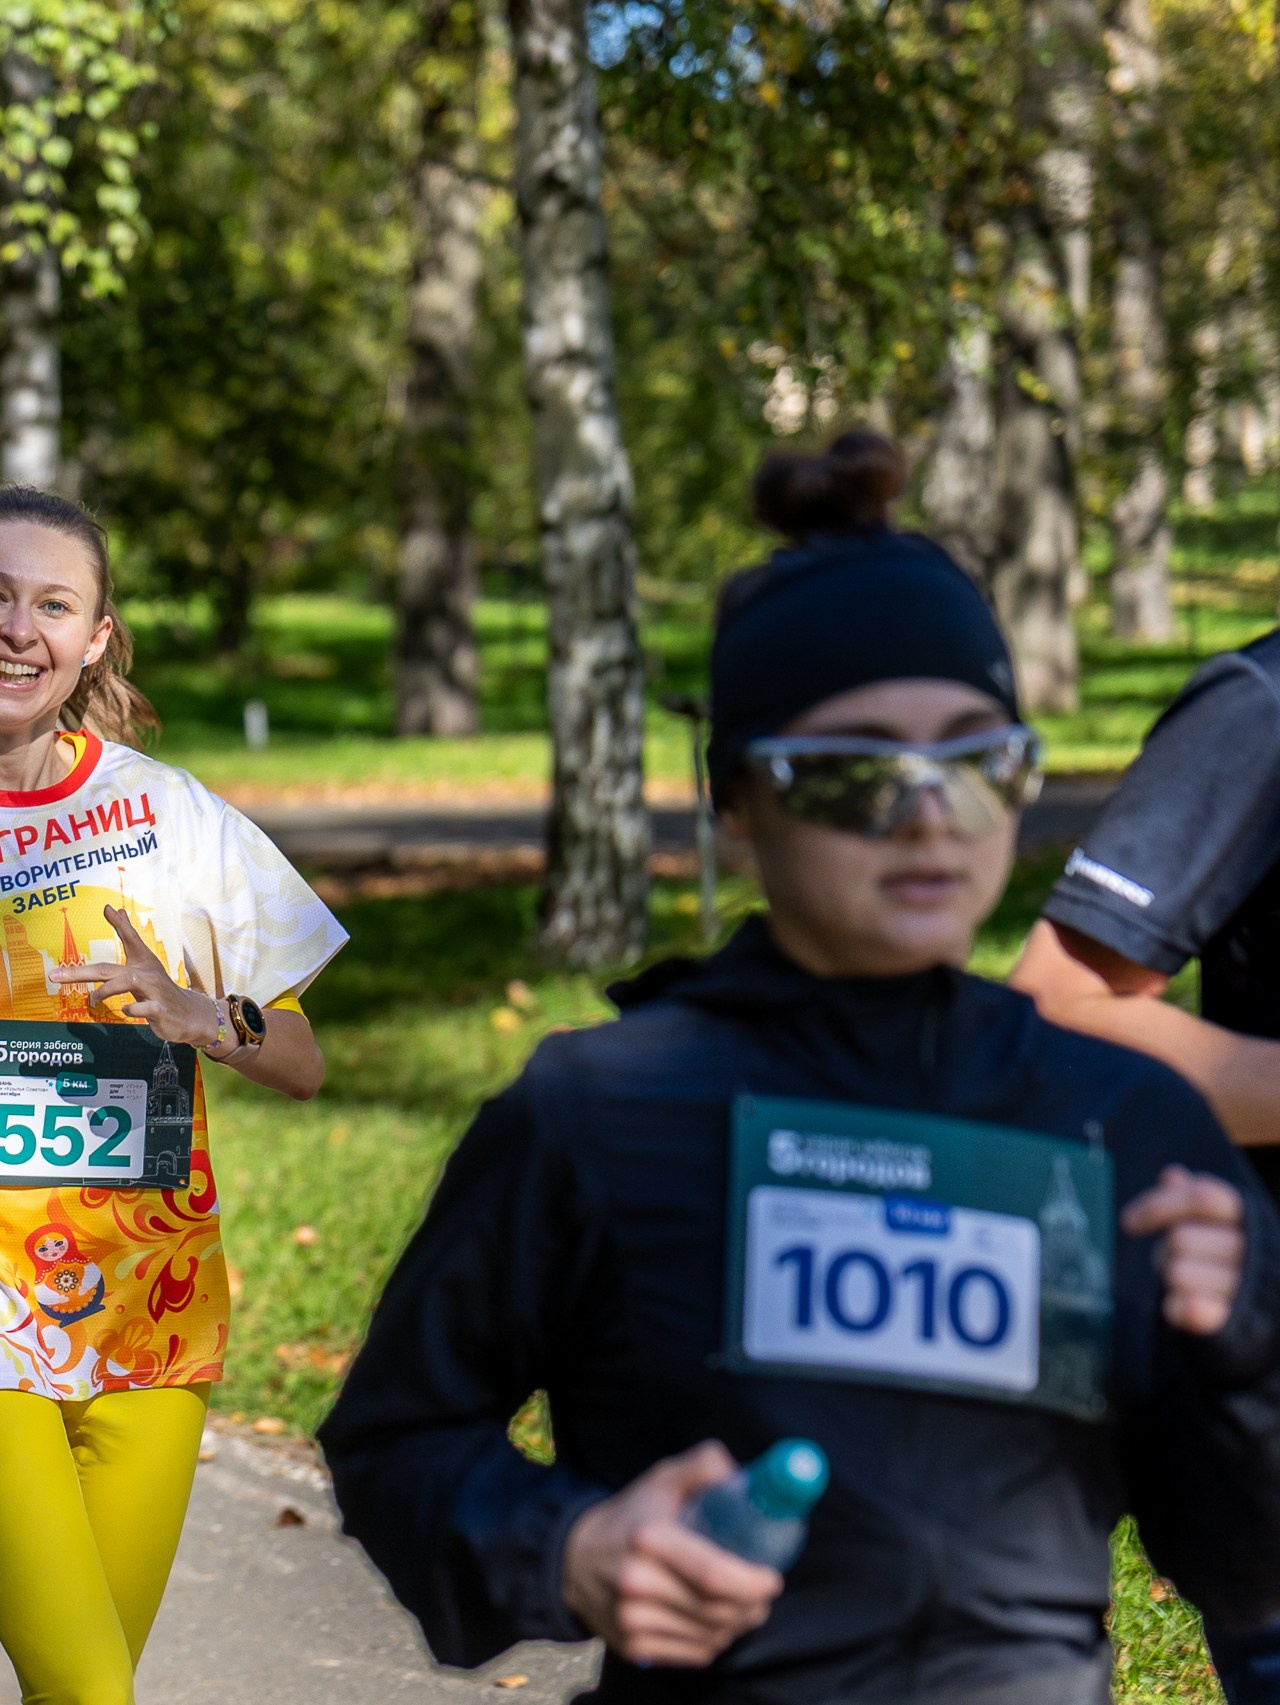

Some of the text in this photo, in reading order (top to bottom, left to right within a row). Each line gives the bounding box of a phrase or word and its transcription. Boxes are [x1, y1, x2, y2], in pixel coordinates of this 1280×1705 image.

[11, 879, 81, 915] ЗАБЕГ
[10, 1040, 84, 1051] серия забегов
[9, 1051, 84, 1067] городов
[62, 1079, 88, 1089] 5 км
[775, 1245, 1011, 1350] 1010
